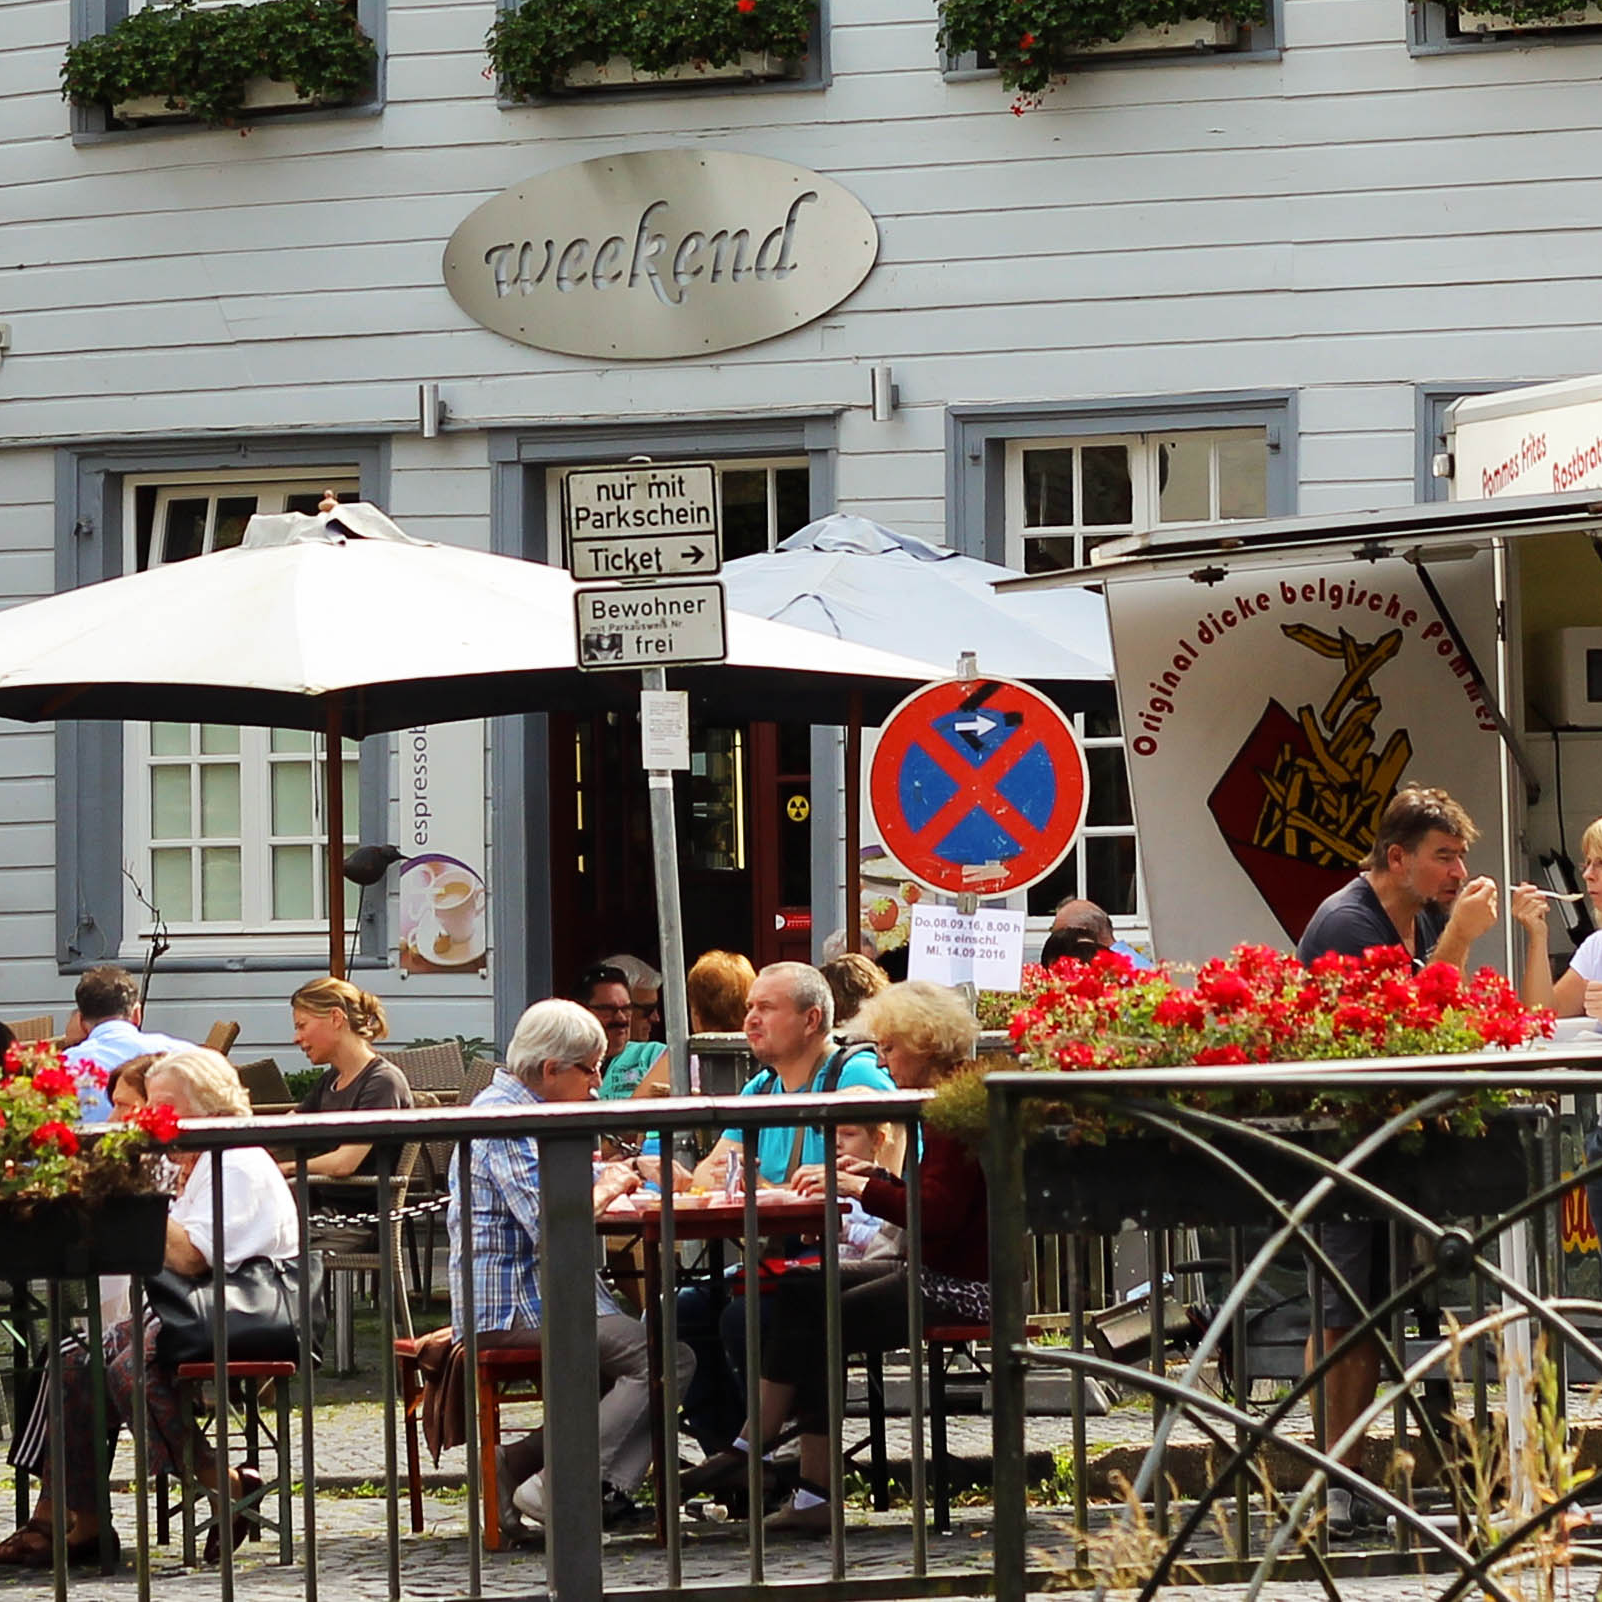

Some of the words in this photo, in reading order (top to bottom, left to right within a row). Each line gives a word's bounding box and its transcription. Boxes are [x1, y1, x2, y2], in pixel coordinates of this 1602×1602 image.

[484, 191, 818, 306] weekend
[1482, 452, 1519, 498] Pommes
[1520, 432, 1546, 473] Frites
[597, 481, 637, 502] nur
[648, 474, 686, 499] mit
[575, 500, 711, 531] Parkschein
[588, 546, 663, 572] Ticket
[591, 596, 707, 620] Bewohner
[635, 633, 674, 655] frei
[1132, 639, 1200, 757] Original
[1197, 593, 1271, 645] dicke
[1279, 578, 1419, 628] belgische
[408, 723, 432, 846] espressob
[934, 931, 951, 943] bis
[954, 933, 999, 946] einschl.
[986, 920, 1011, 933] 8.00
[1013, 923, 1021, 933] h
[926, 945, 943, 956] Mi.
[947, 947, 1006, 960] 14.09.2016
